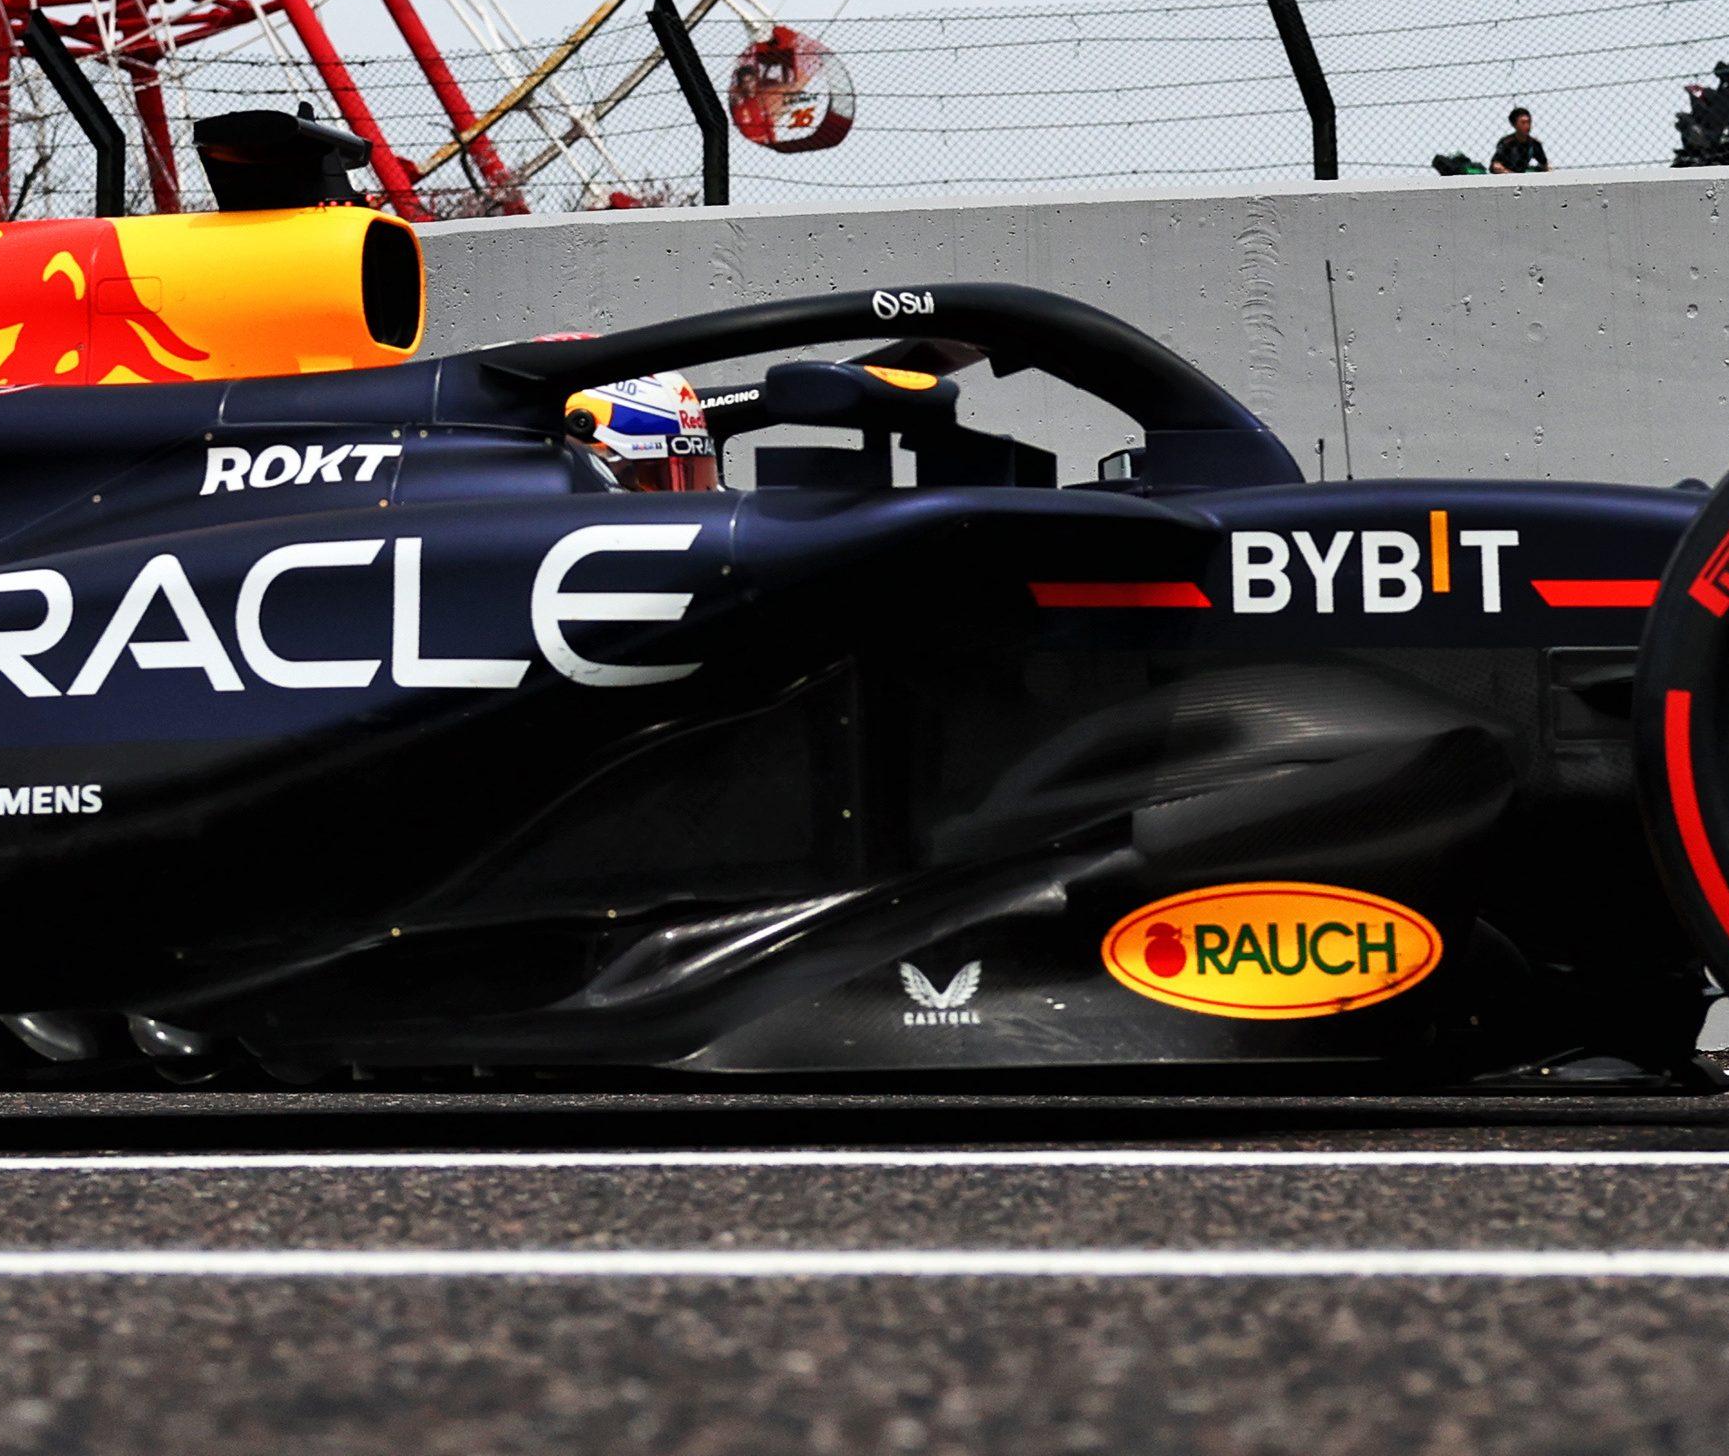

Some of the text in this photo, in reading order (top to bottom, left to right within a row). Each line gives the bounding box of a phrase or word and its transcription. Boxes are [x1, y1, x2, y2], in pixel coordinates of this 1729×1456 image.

[899, 291, 935, 314] Sui
[701, 389, 760, 410] LRACING
[672, 436, 715, 454] ORA
[199, 443, 402, 496] ROKT
[1231, 510, 1520, 614] BYBIT
[1195, 922, 1397, 976] RAUCH
